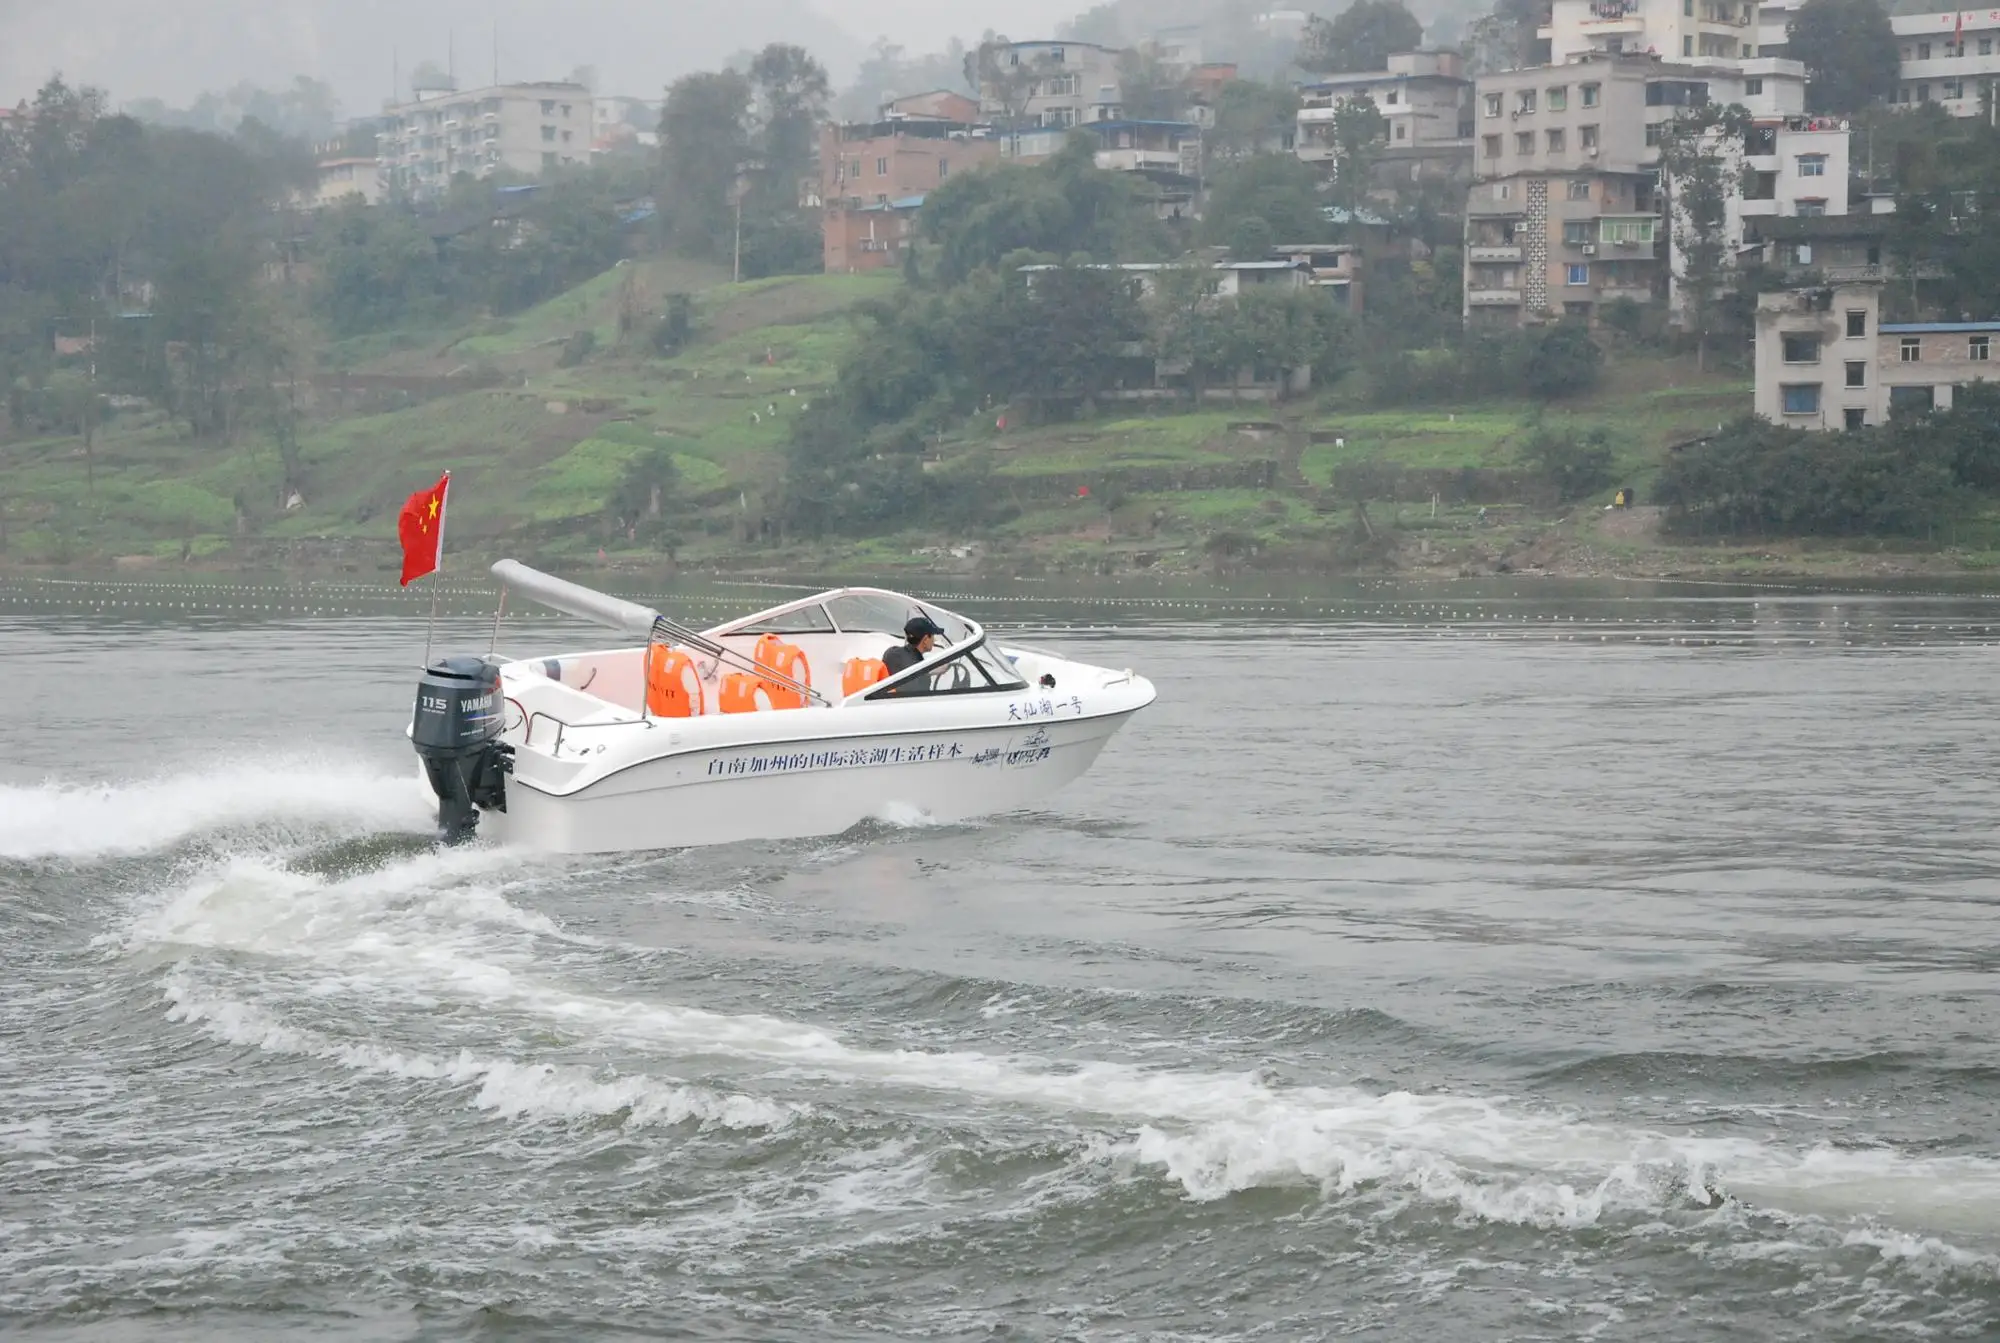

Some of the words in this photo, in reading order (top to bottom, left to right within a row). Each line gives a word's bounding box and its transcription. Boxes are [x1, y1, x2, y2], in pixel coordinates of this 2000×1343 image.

[421, 696, 447, 710] 115
[1008, 696, 1082, 720] 天仙湖一号
